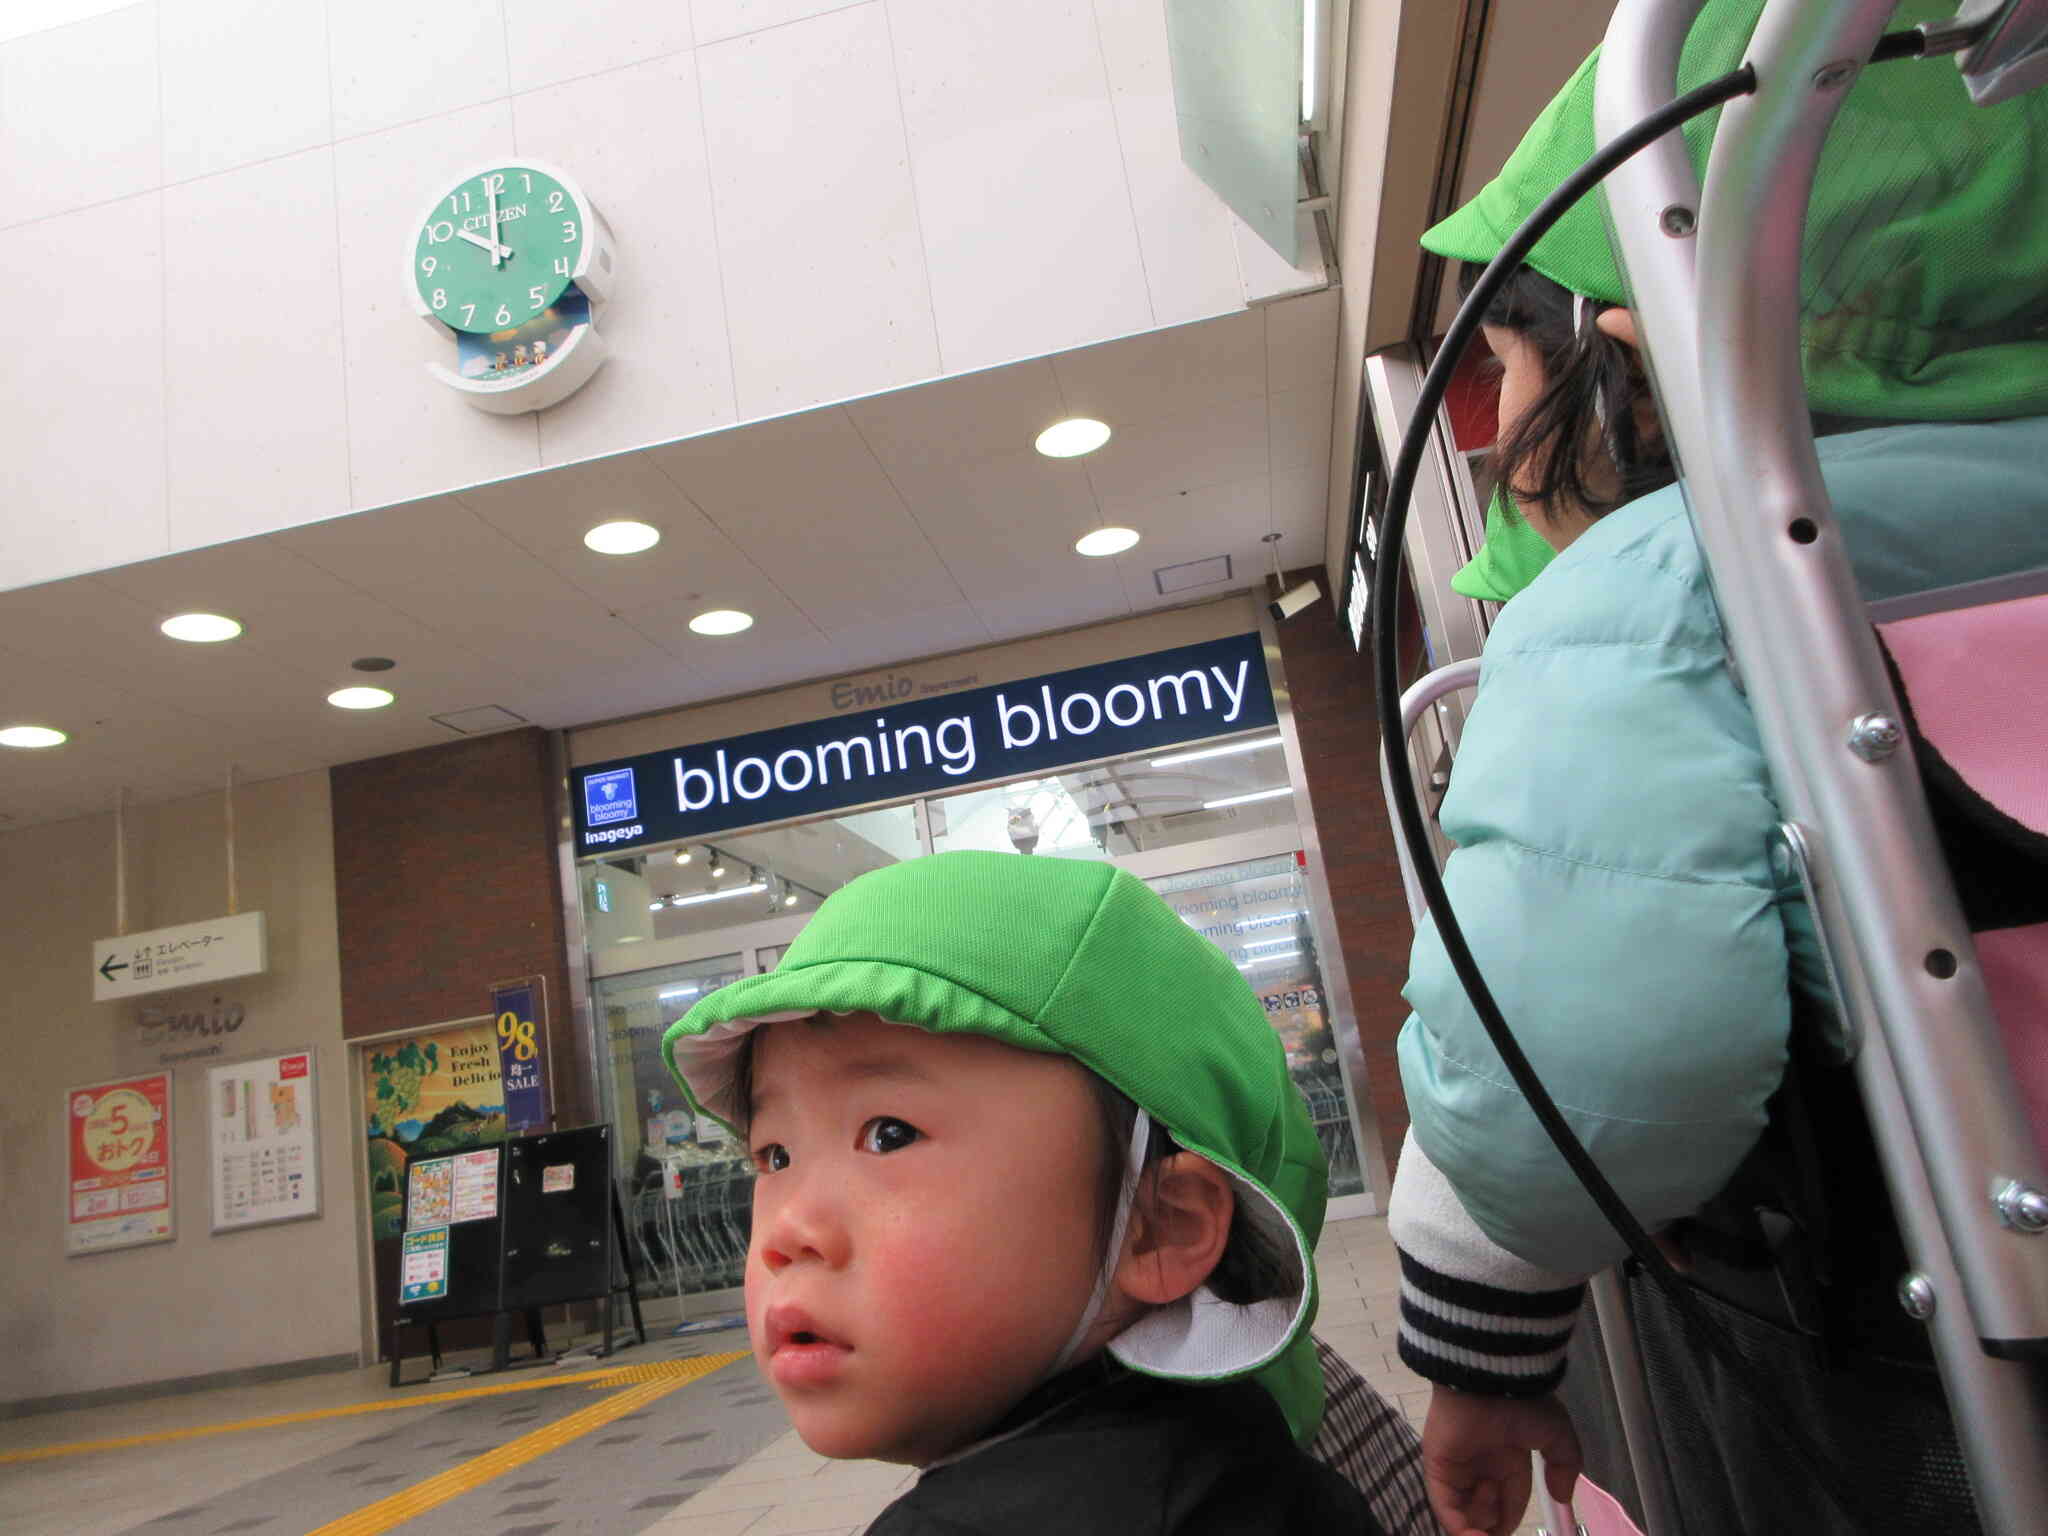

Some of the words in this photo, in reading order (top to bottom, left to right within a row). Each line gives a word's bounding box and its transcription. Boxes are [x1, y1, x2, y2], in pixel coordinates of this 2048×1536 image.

[481, 174, 505, 197] 12
[521, 174, 531, 194] 1
[449, 192, 471, 215] 11
[549, 191, 565, 213] 2
[463, 203, 528, 232] CITZEN
[426, 221, 453, 244] 10
[562, 221, 577, 243] 3
[421, 256, 437, 278] 9
[554, 256, 569, 278] 4
[432, 287, 447, 310] 8
[529, 286, 545, 309] 5
[460, 304, 476, 327] 7
[495, 304, 512, 326] 6
[831, 674, 912, 710] Emio
[674, 716, 975, 812] blooming
[996, 661, 1249, 749] bloomy
[590, 799, 633, 814] blooming
[1174, 895, 1240, 916] looming
[157, 935, 224, 956] エレベーター
[497, 1011, 536, 1061] 98
[450, 1043, 489, 1058] Enjoy
[451, 1057, 490, 1072] Fresh
[507, 1075, 540, 1091] SALE
[110, 1104, 129, 1136] 5
